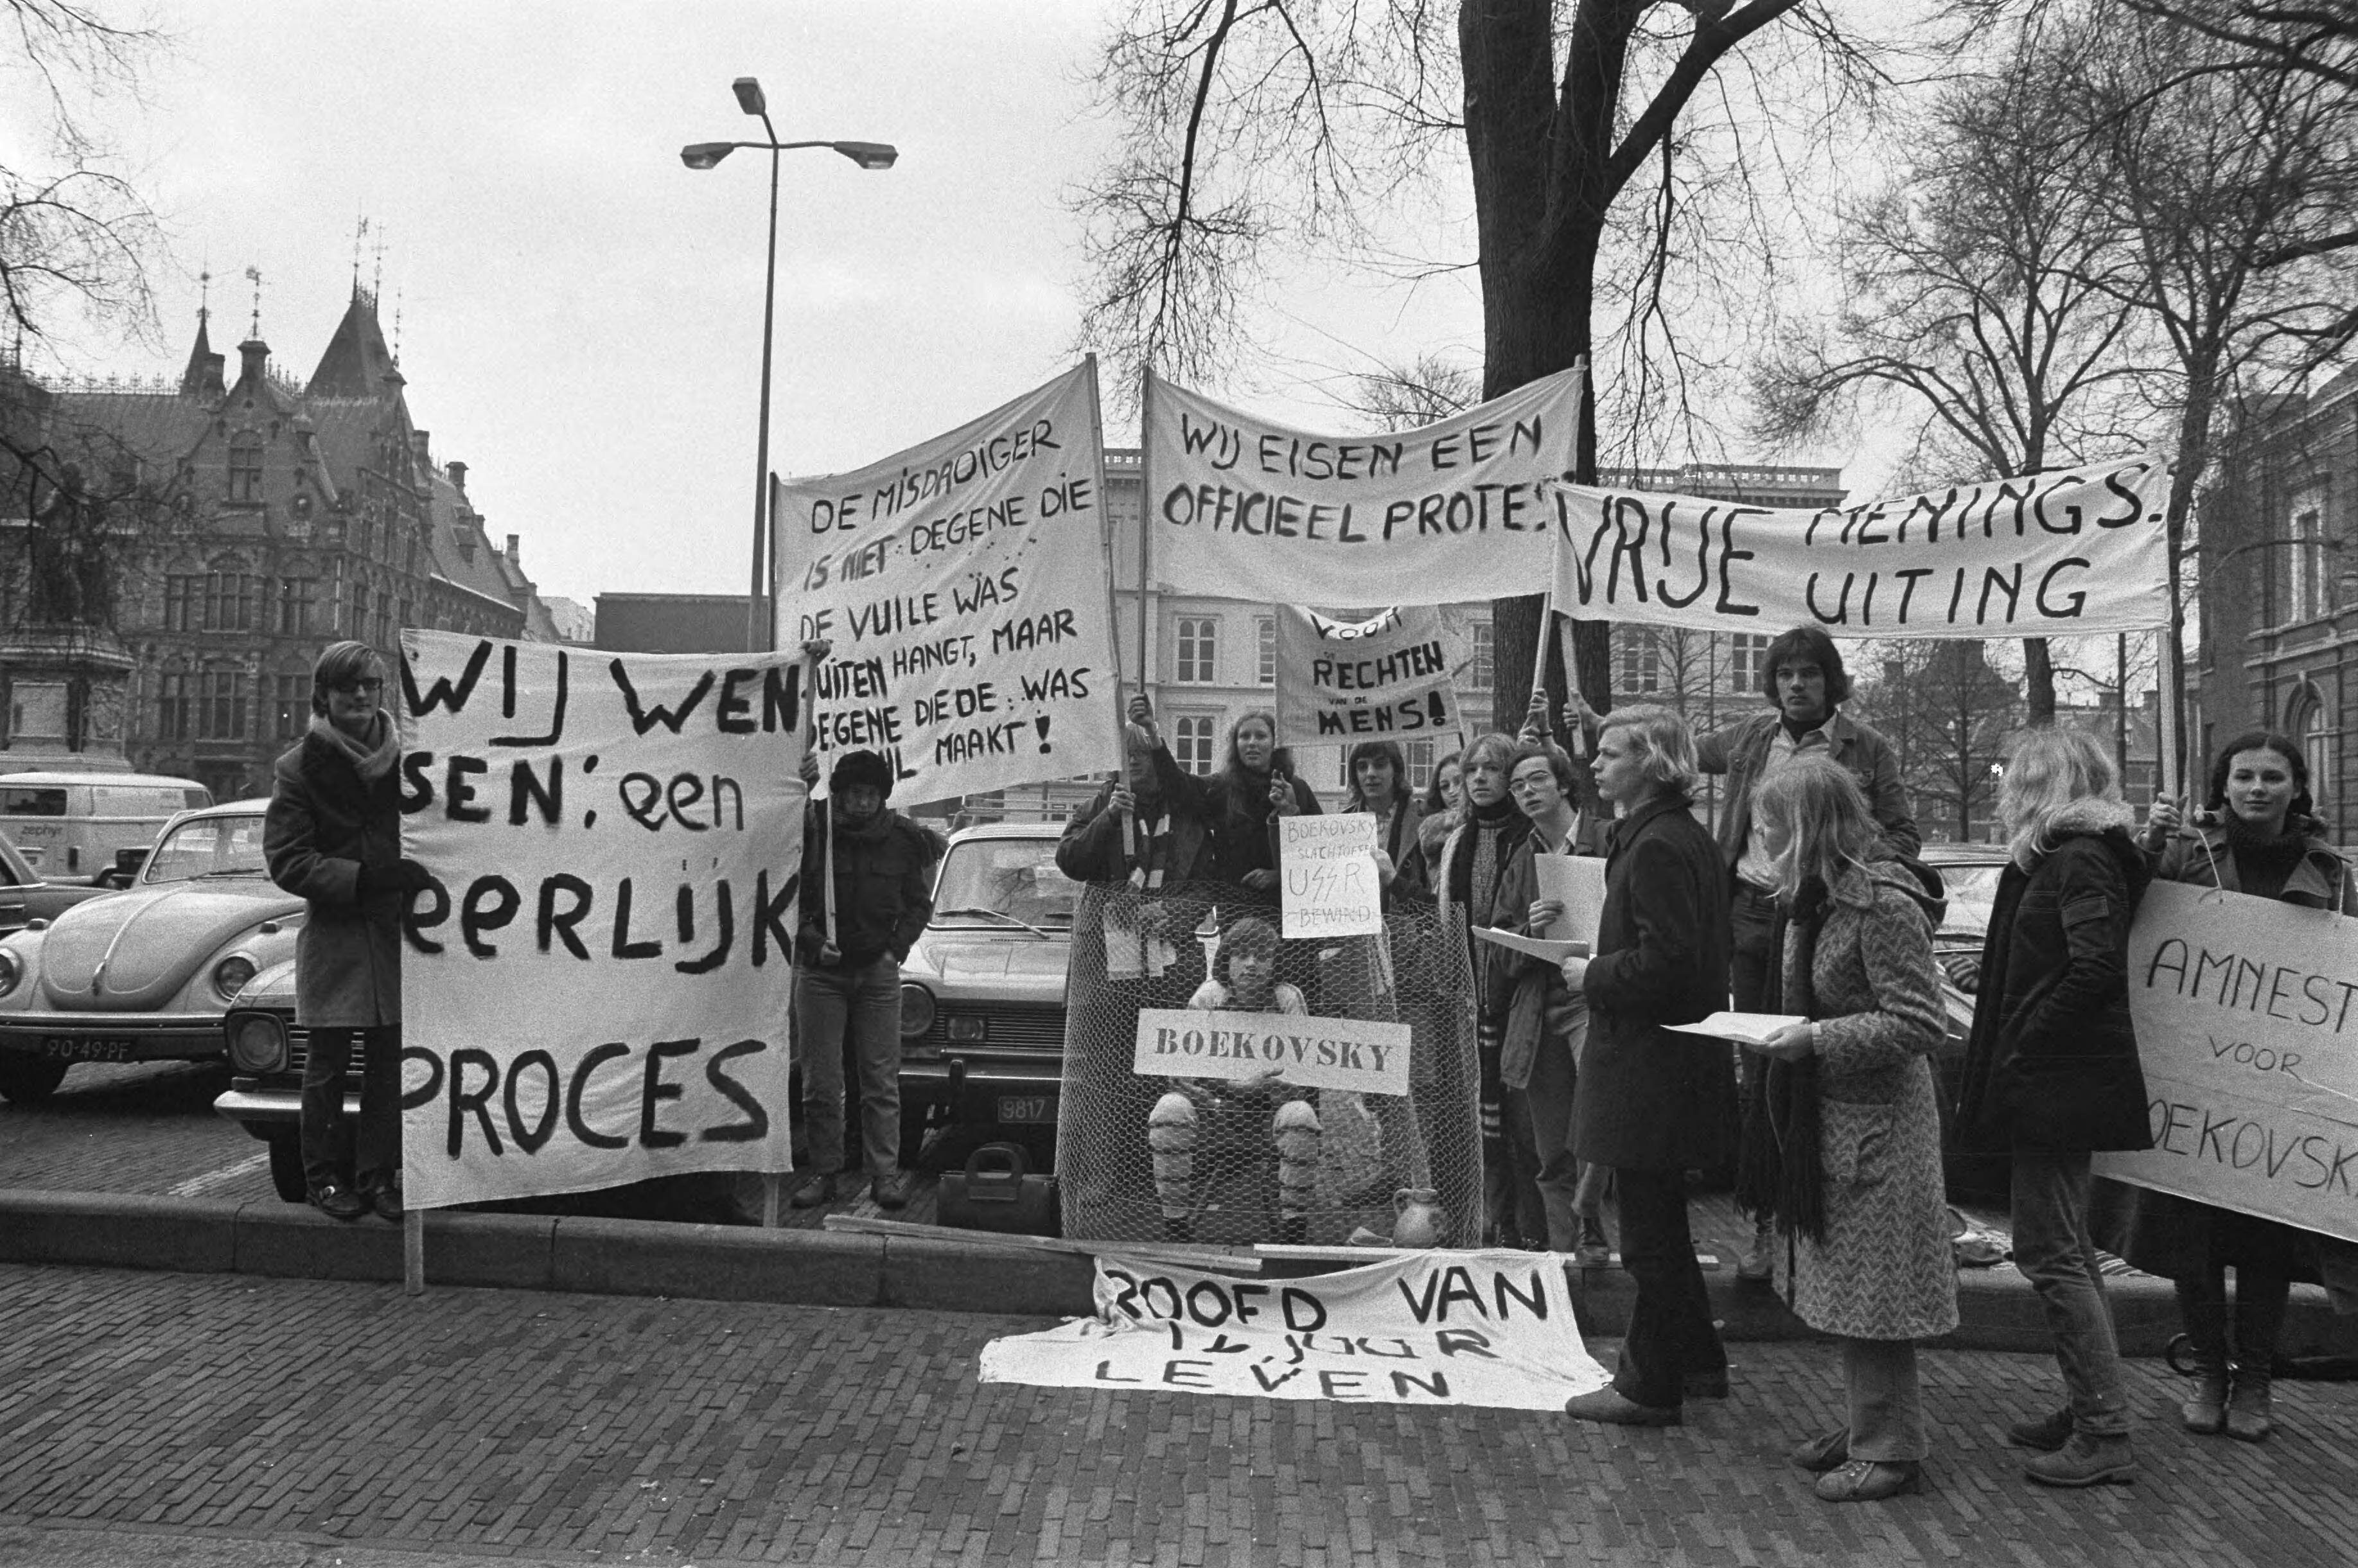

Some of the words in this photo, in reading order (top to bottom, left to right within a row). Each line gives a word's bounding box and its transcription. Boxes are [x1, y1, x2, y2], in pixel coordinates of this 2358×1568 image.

[1182, 412, 1240, 470] WIJ
[1260, 434, 1402, 480] EISEN
[1431, 414, 1542, 471] EEN
[804, 554, 832, 591] IS
[841, 534, 897, 583] NIET
[910, 496, 1028, 555] DEGENE
[1041, 472, 1092, 518] DIE
[811, 495, 863, 533] DE
[1163, 482, 1367, 542] OFFICIEEL
[1554, 490, 1774, 617] VRIJE
[800, 608, 834, 641] DE
[848, 592, 938, 642] VUILE
[953, 567, 1019, 616] WAS
[1806, 557, 2091, 626] UITING
[893, 635, 977, 678] HANGT,
[992, 608, 1078, 654] MAAR
[1310, 606, 1402, 640] VOOR
[400, 639, 568, 746] WIJ
[1314, 640, 1445, 690] RECHTEN
[811, 706, 903, 752] EGENE
[915, 689, 951, 727] DIE
[956, 682, 998, 718] DE
[1021, 667, 1091, 701] WAS
[1317, 691, 1446, 736] MENS!
[400, 751, 599, 829] SEN:
[619, 772, 744, 831] een
[1287, 820, 1376, 843] BOEKOVSKY
[1155, 1028, 1393, 1073] BOEKOVSKY
[2208, 1035, 2301, 1081] VOOR
[401, 1038, 769, 1160] PROCES
[1001, 1098, 1045, 1120] 9817
[1396, 1266, 1548, 1324] VAN
[1095, 1359, 1451, 1398] LEVEN
